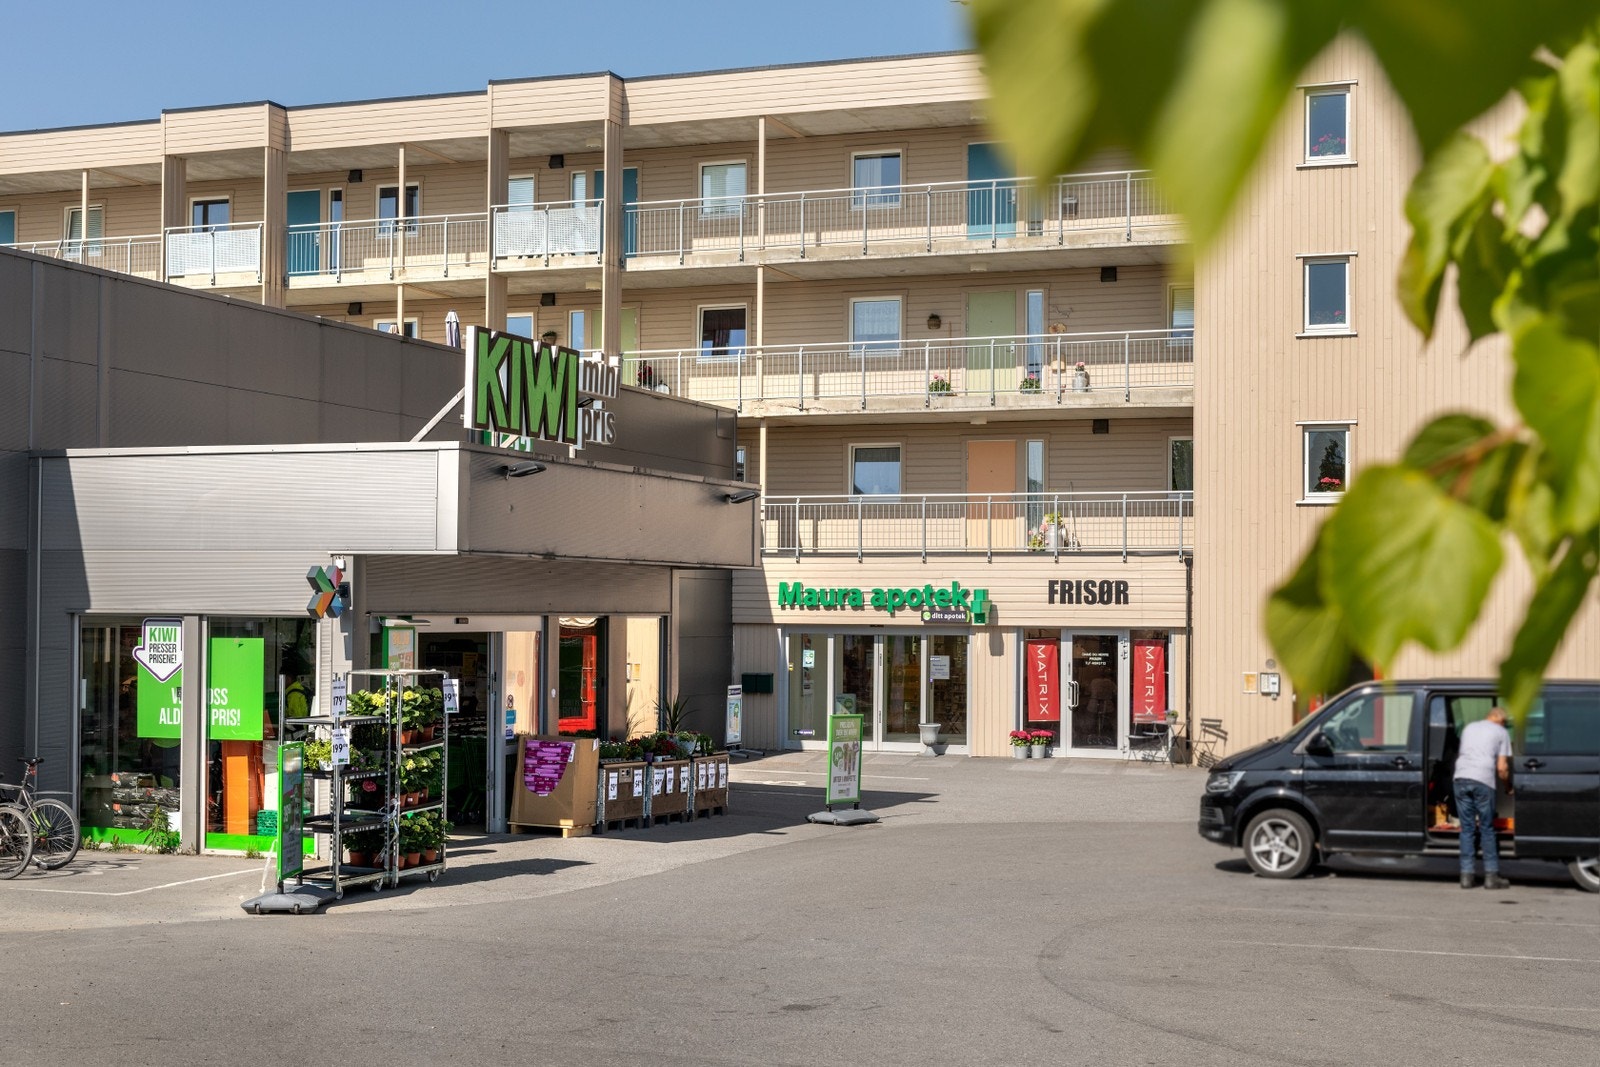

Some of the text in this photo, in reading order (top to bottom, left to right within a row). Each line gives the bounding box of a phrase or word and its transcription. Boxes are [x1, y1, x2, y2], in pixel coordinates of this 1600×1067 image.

[472, 327, 580, 444] KIWI
[581, 354, 620, 398] mini
[580, 402, 616, 449] pris
[778, 581, 970, 614] Maura apotek
[1048, 580, 1129, 605] FRISØR
[944, 612, 966, 621] apotek
[149, 627, 177, 642] KIWI
[149, 643, 177, 653] PRESSER
[149, 654, 177, 664] PRISENE!
[1036, 644, 1049, 715] MATRIX
[1144, 645, 1155, 716] MATRIX
[159, 707, 241, 727] ALD PRIS!
